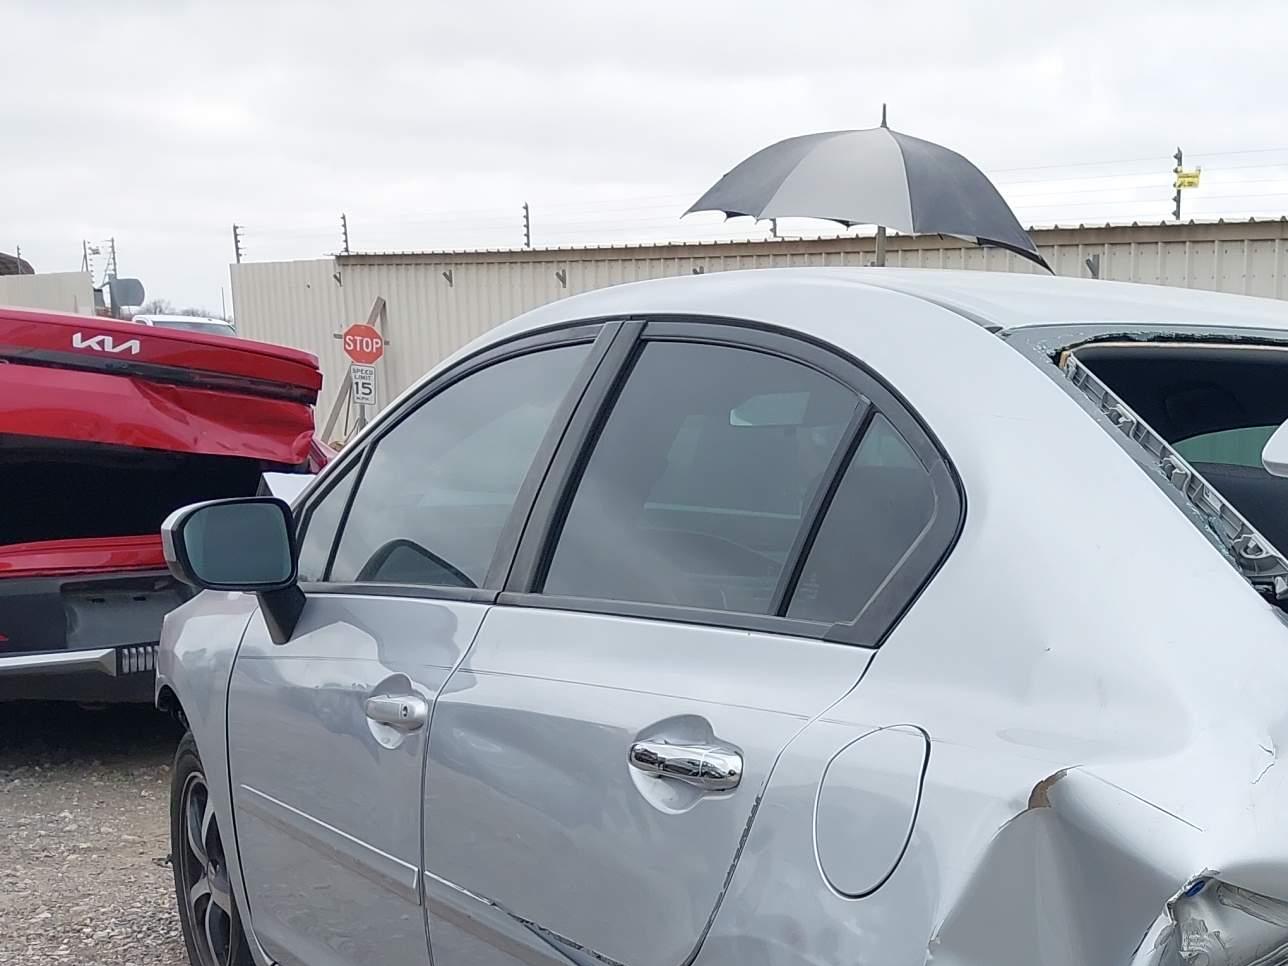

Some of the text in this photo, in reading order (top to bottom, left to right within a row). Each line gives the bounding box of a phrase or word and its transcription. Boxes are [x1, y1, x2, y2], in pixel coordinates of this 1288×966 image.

[72, 332, 140, 355] KIA
[345, 335, 382, 353] STOP
[352, 367, 374, 376] SPEED
[354, 381, 373, 396] 15
